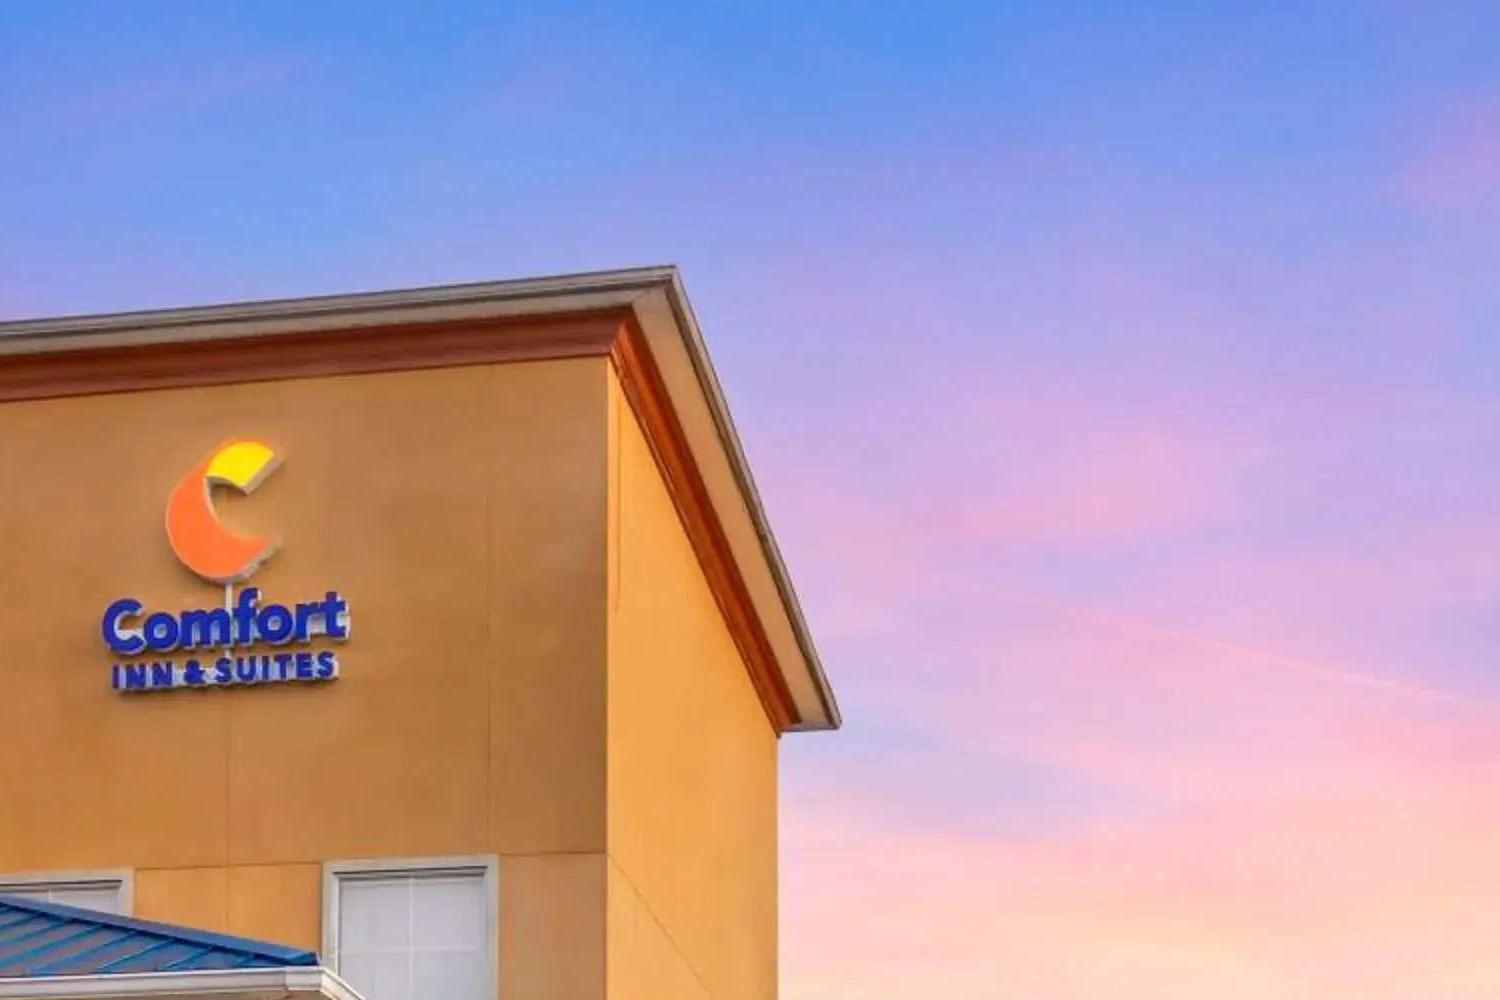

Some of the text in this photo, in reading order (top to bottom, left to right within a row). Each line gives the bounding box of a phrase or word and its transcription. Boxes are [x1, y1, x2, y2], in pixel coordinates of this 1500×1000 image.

[102, 588, 349, 654] Comfort
[112, 651, 338, 691] INN & SUITES
